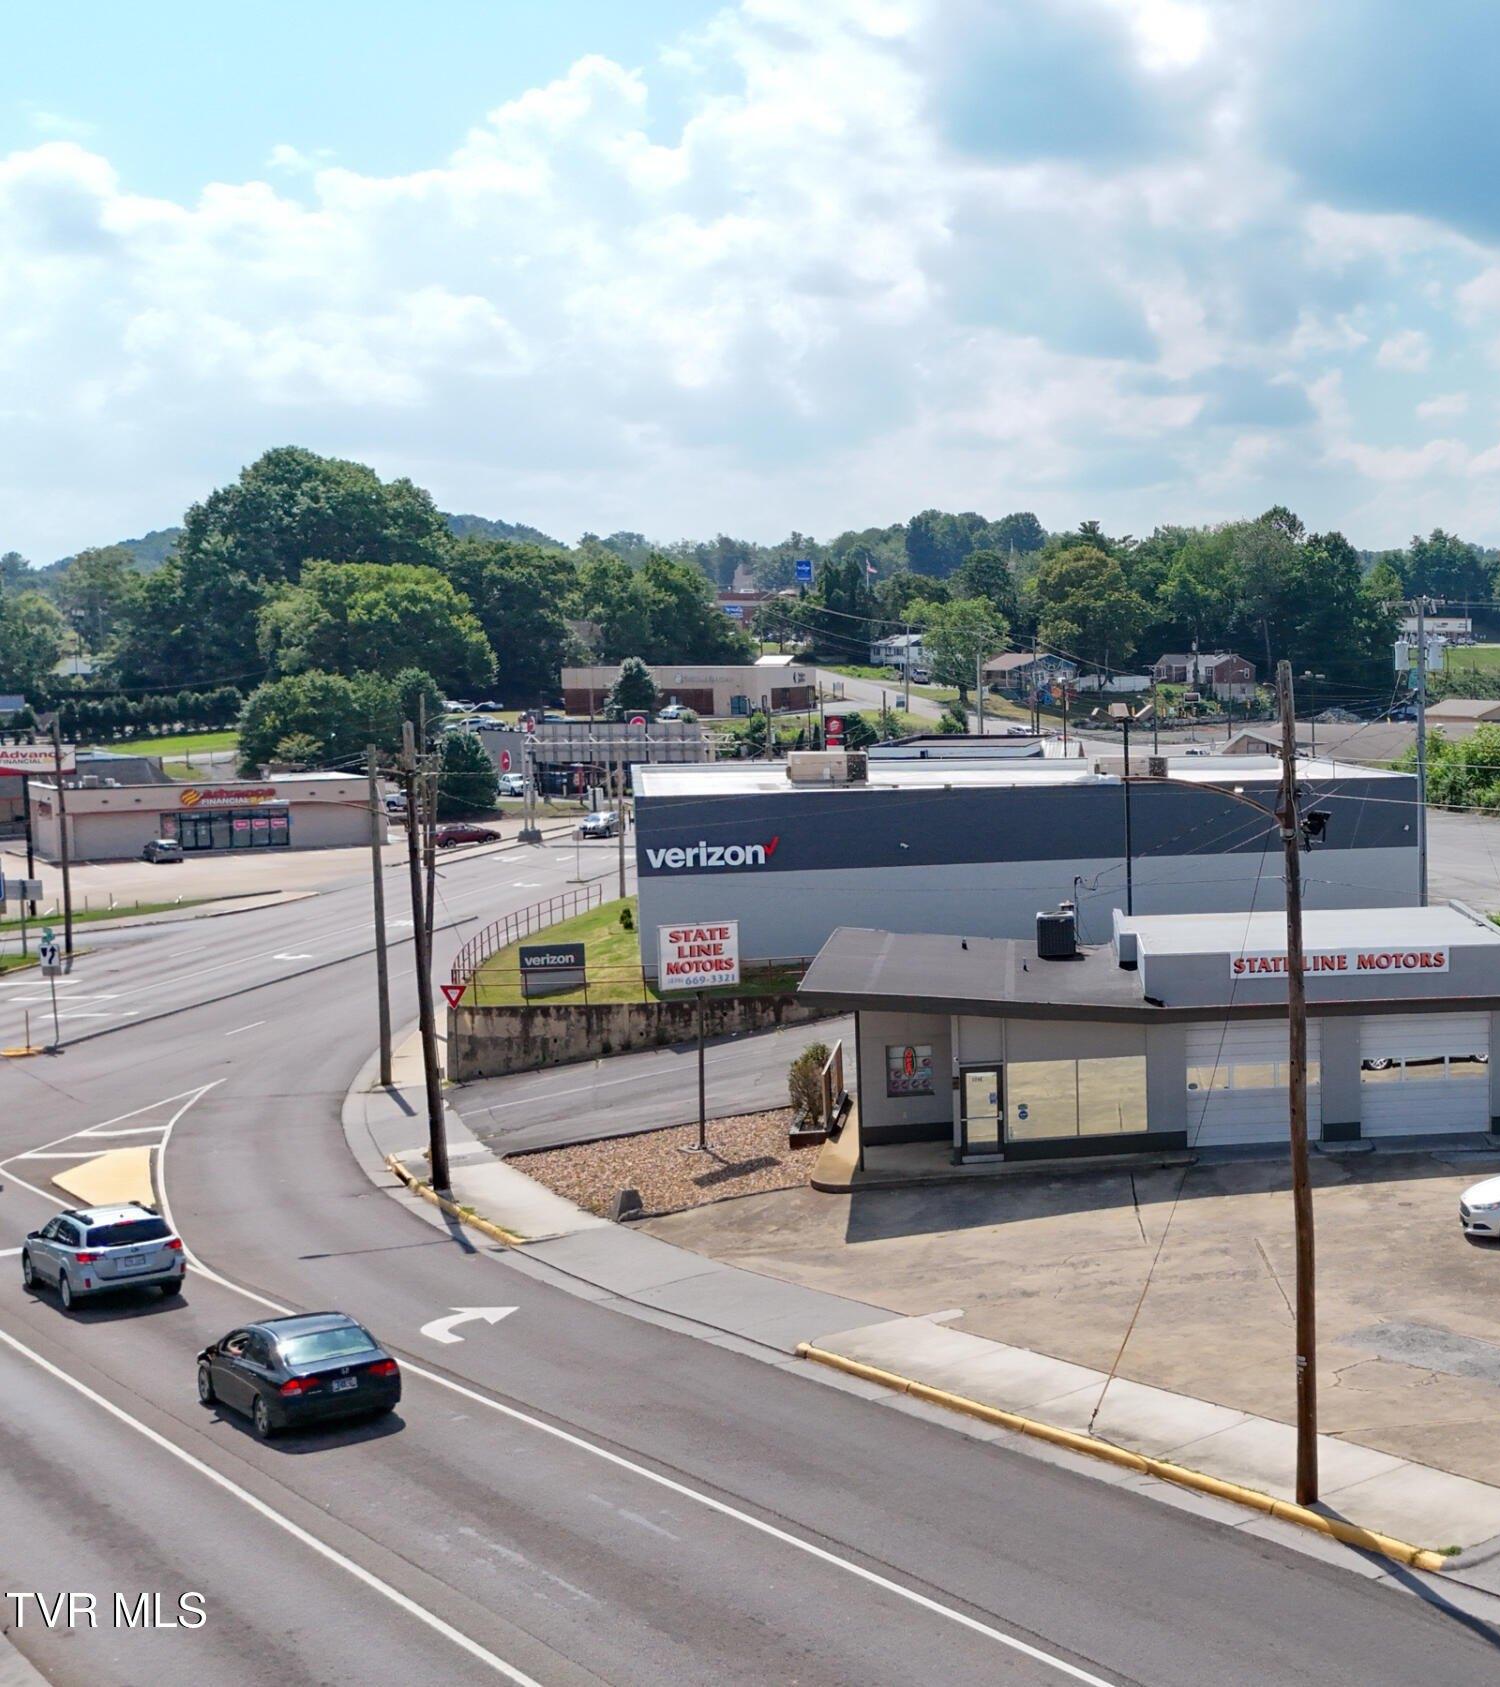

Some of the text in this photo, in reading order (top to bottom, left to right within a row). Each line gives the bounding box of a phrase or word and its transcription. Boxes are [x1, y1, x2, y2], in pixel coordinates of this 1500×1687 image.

[201, 797, 249, 806] FINANCIAL
[646, 841, 766, 869] verizon
[668, 927, 731, 943] STATE
[677, 943, 725, 959] LINE
[524, 953, 576, 966] verizon
[666, 958, 735, 975] MOTORS
[1301, 954, 1348, 971] LINE
[1356, 952, 1445, 970] MOTORS
[685, 973, 735, 985] 669-3321
